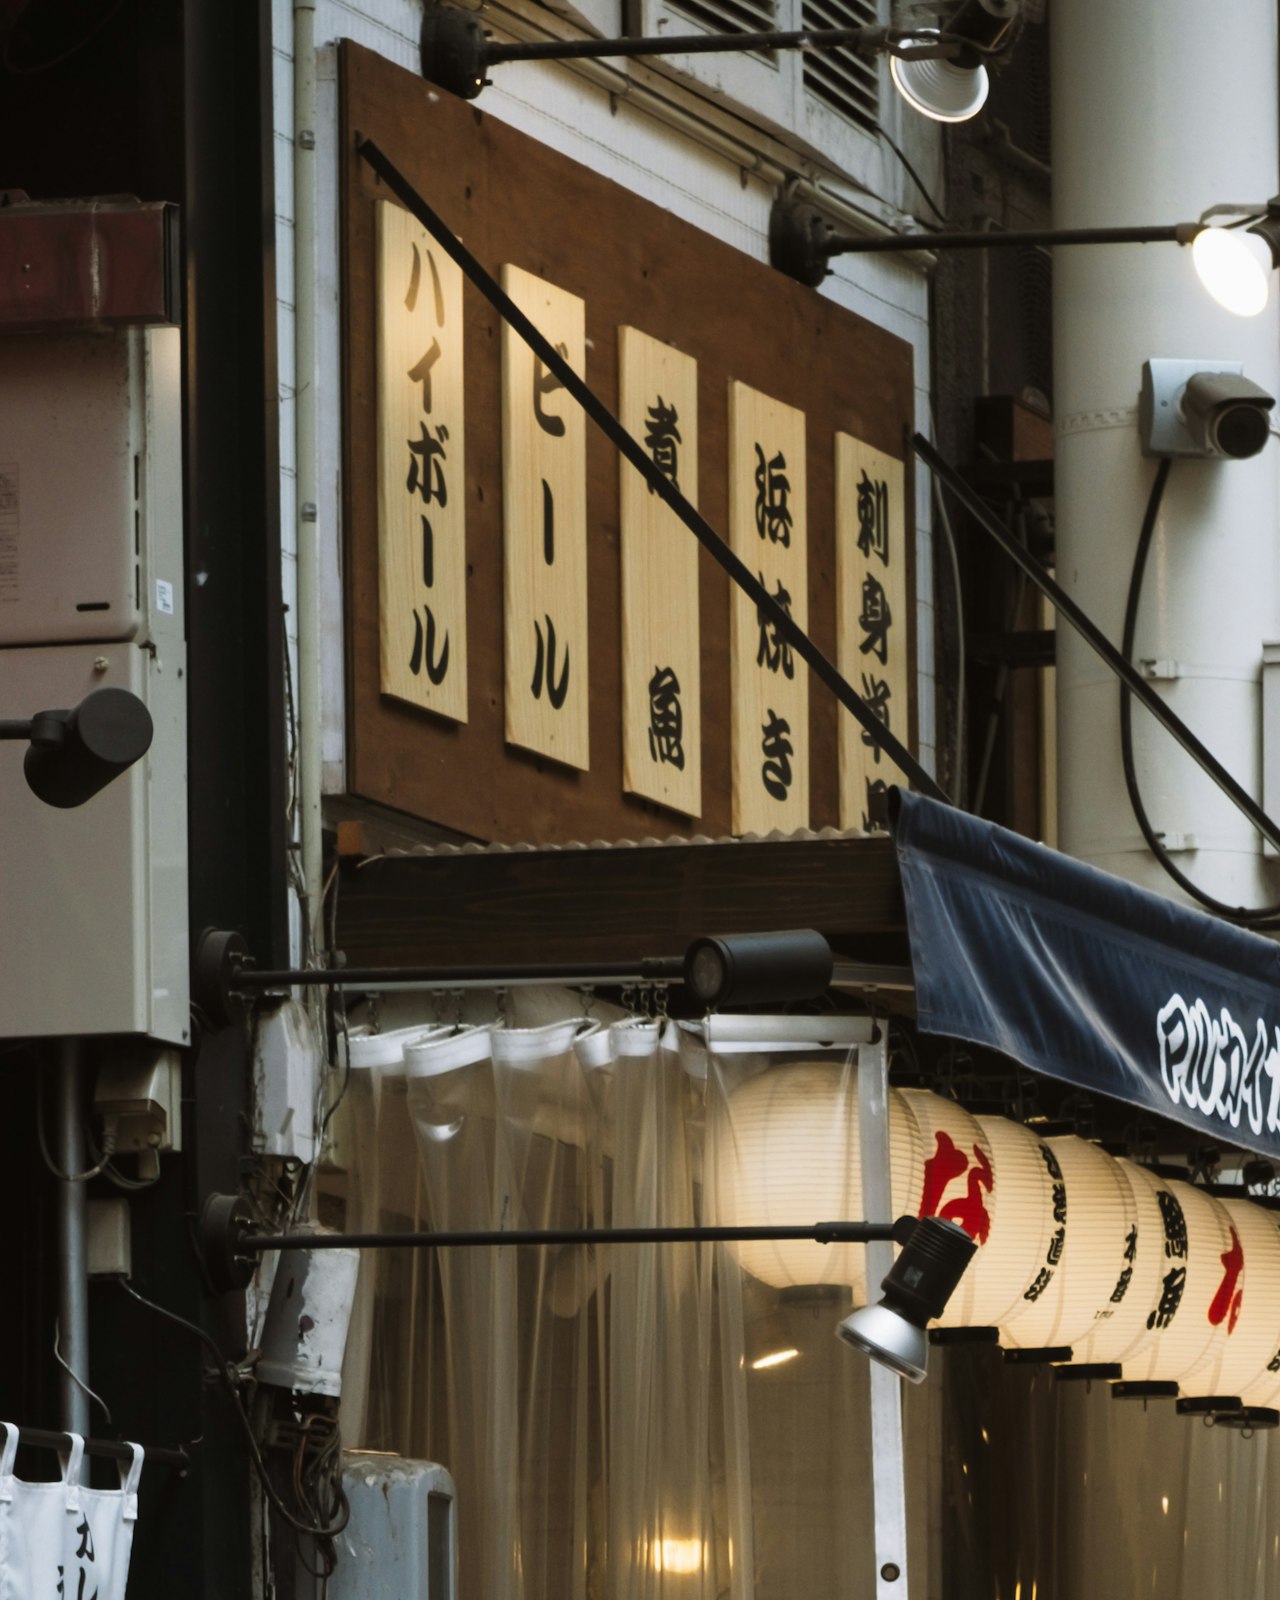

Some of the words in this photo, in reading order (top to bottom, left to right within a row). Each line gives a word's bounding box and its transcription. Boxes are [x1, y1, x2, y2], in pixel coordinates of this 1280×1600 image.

[403, 241, 450, 687] ハイボール
[530, 341, 571, 711] ビール
